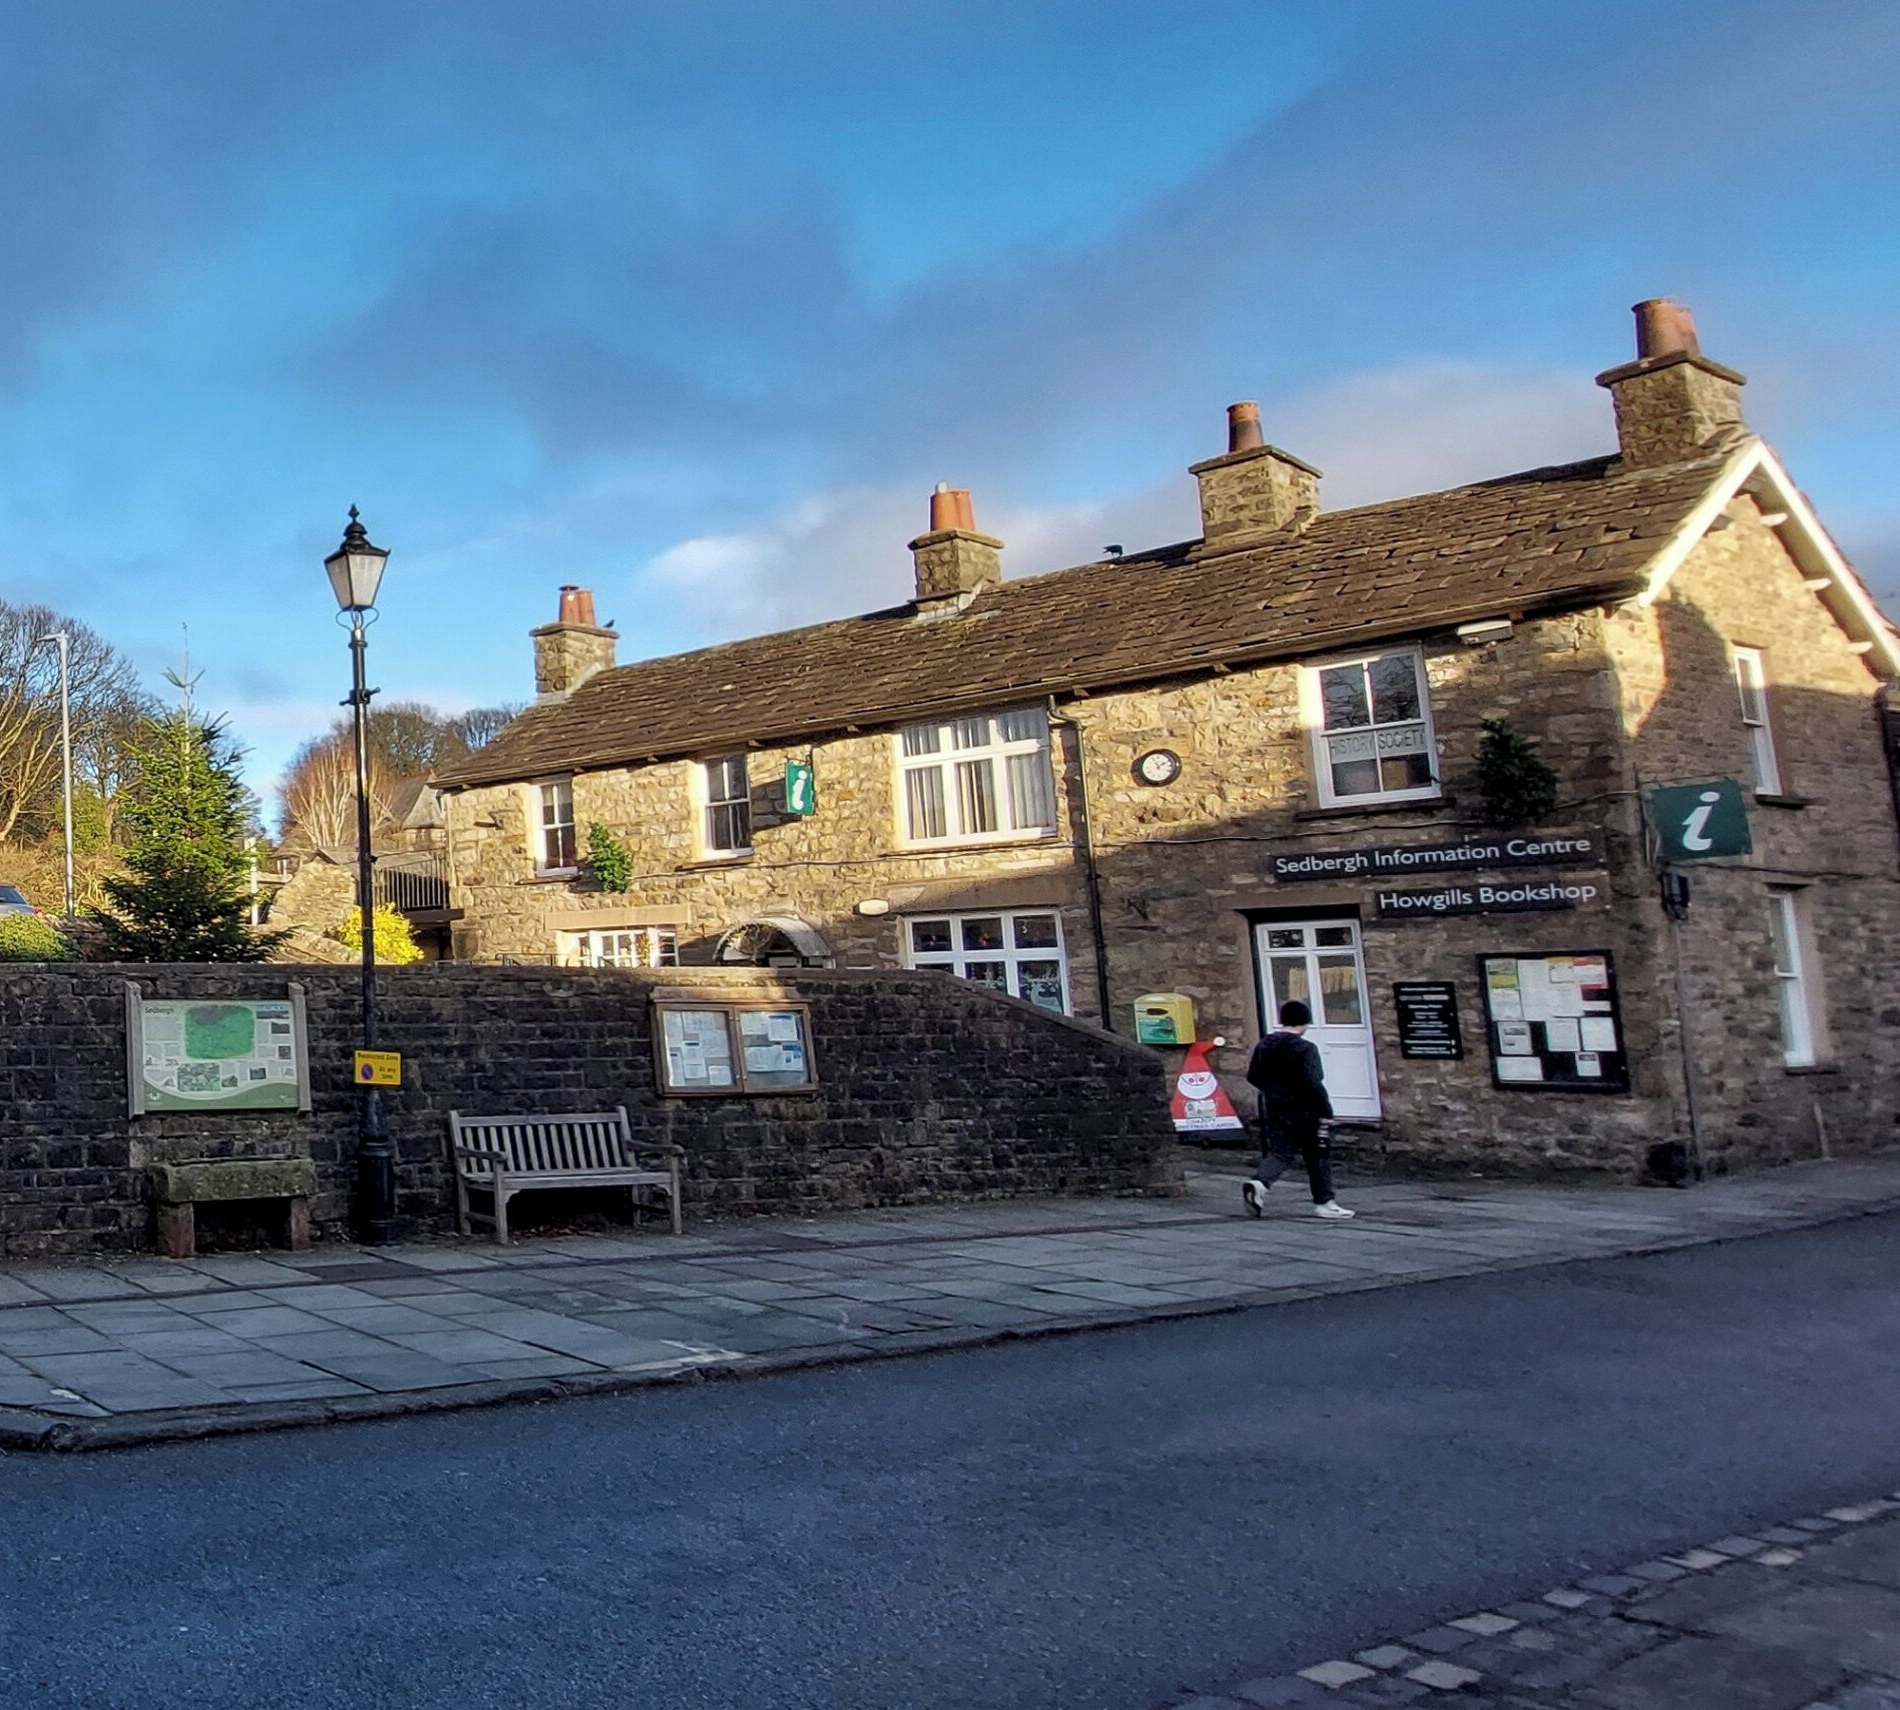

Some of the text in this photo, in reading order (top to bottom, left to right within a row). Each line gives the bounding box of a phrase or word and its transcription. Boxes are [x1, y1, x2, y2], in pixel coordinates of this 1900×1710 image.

[1378, 728, 1426, 749] SOCIETY
[1276, 838, 1591, 874] Sedbergh Information Centre
[1379, 883, 1597, 910] Howgills Bookshop
